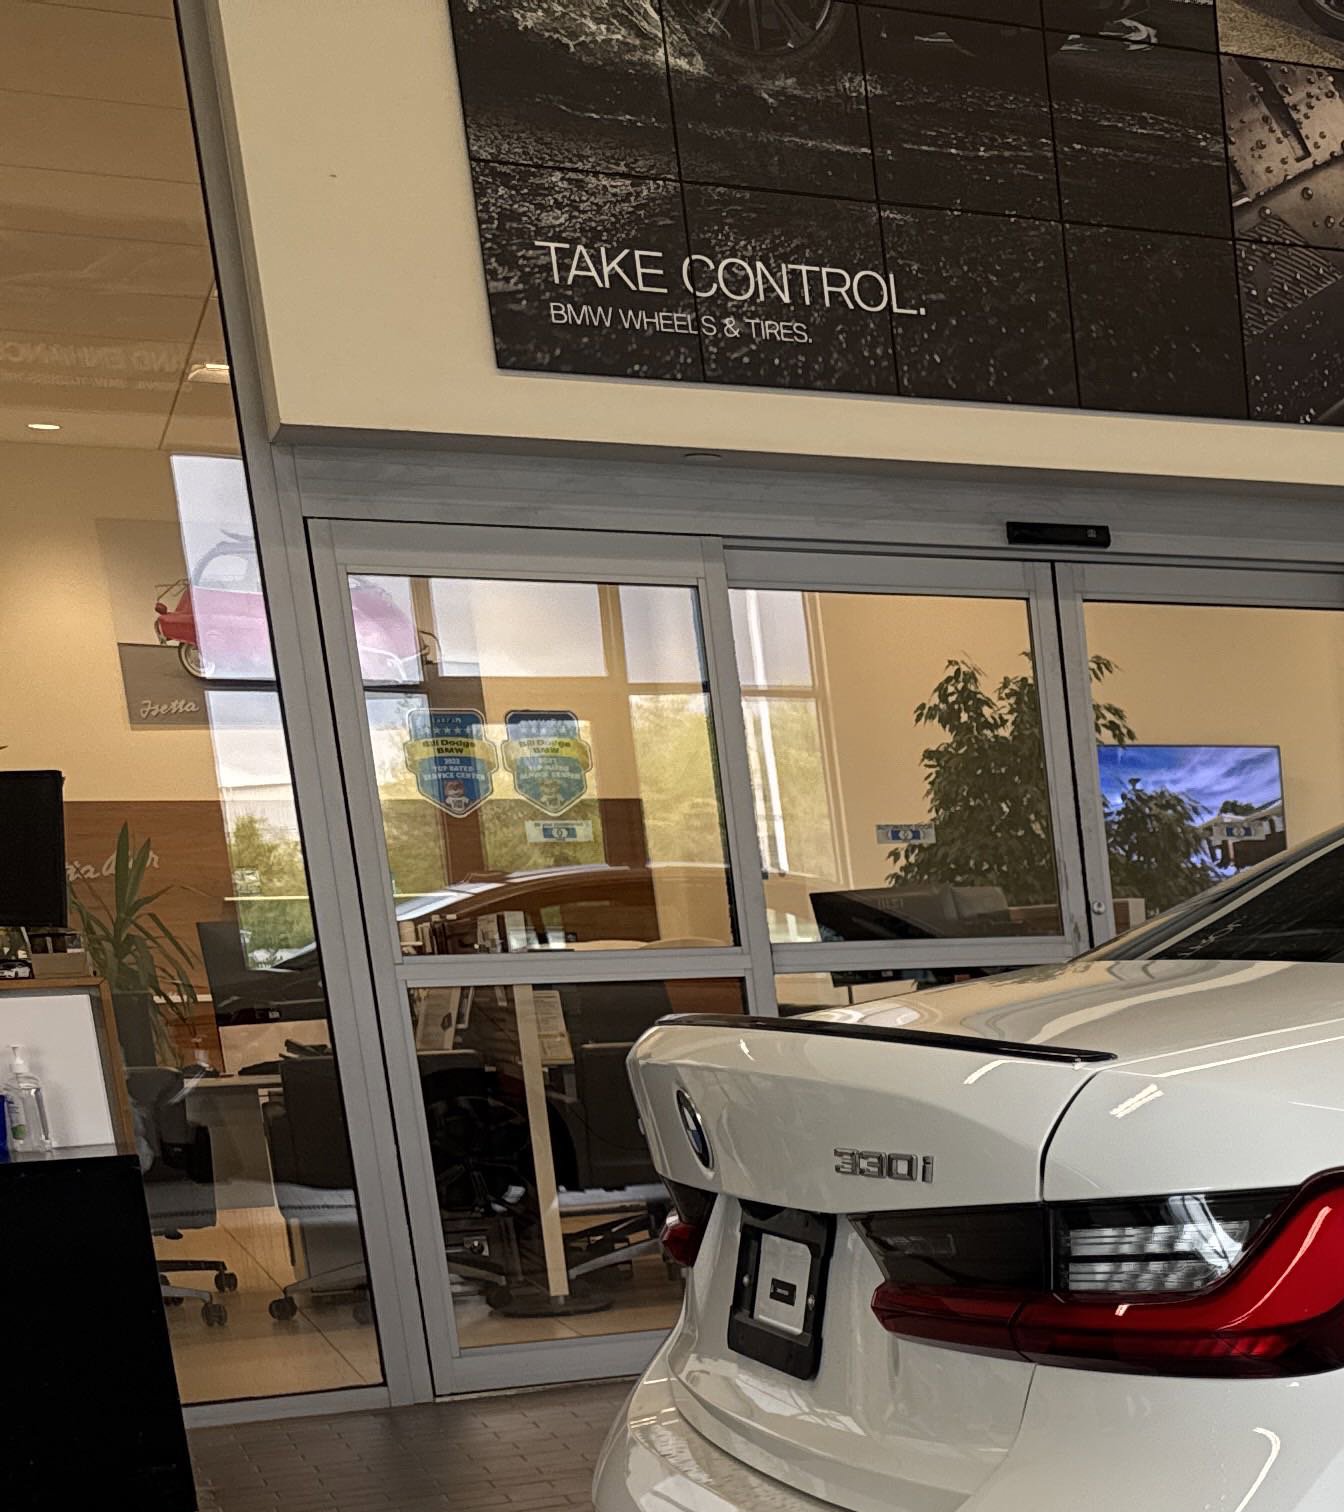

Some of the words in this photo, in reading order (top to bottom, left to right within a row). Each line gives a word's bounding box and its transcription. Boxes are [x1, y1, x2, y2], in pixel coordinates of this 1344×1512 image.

[534, 240, 668, 294] TAKE
[682, 254, 926, 316] CONTROL.
[550, 302, 613, 328] BMW
[618, 308, 718, 336] WHEELS
[723, 317, 741, 338] &
[744, 317, 813, 344] TIRES.
[834, 1147, 935, 1193] 330i
